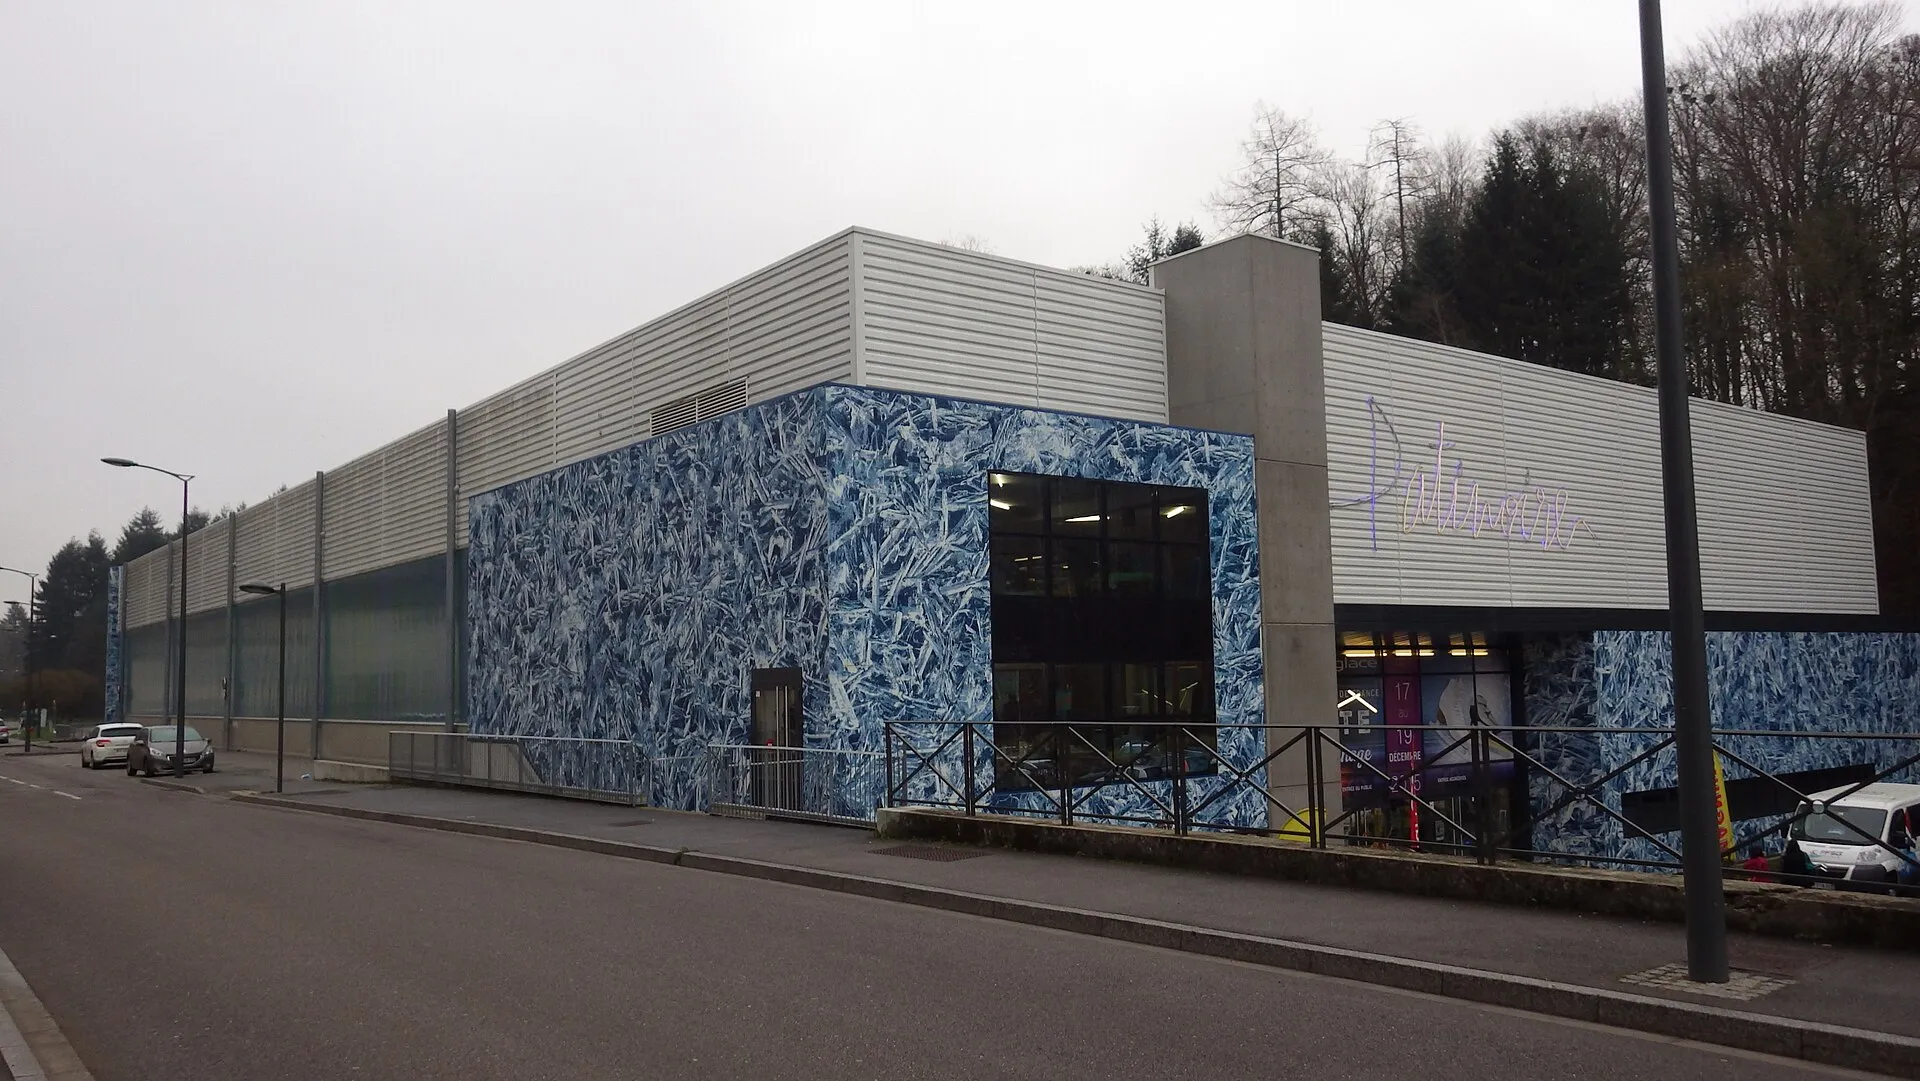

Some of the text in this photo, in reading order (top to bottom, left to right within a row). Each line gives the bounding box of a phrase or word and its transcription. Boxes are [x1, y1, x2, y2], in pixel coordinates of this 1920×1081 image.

[1336, 657, 1378, 672] glace
[1395, 682, 1410, 700] 17
[1398, 708, 1408, 718] au
[1396, 728, 1413, 745] 19
